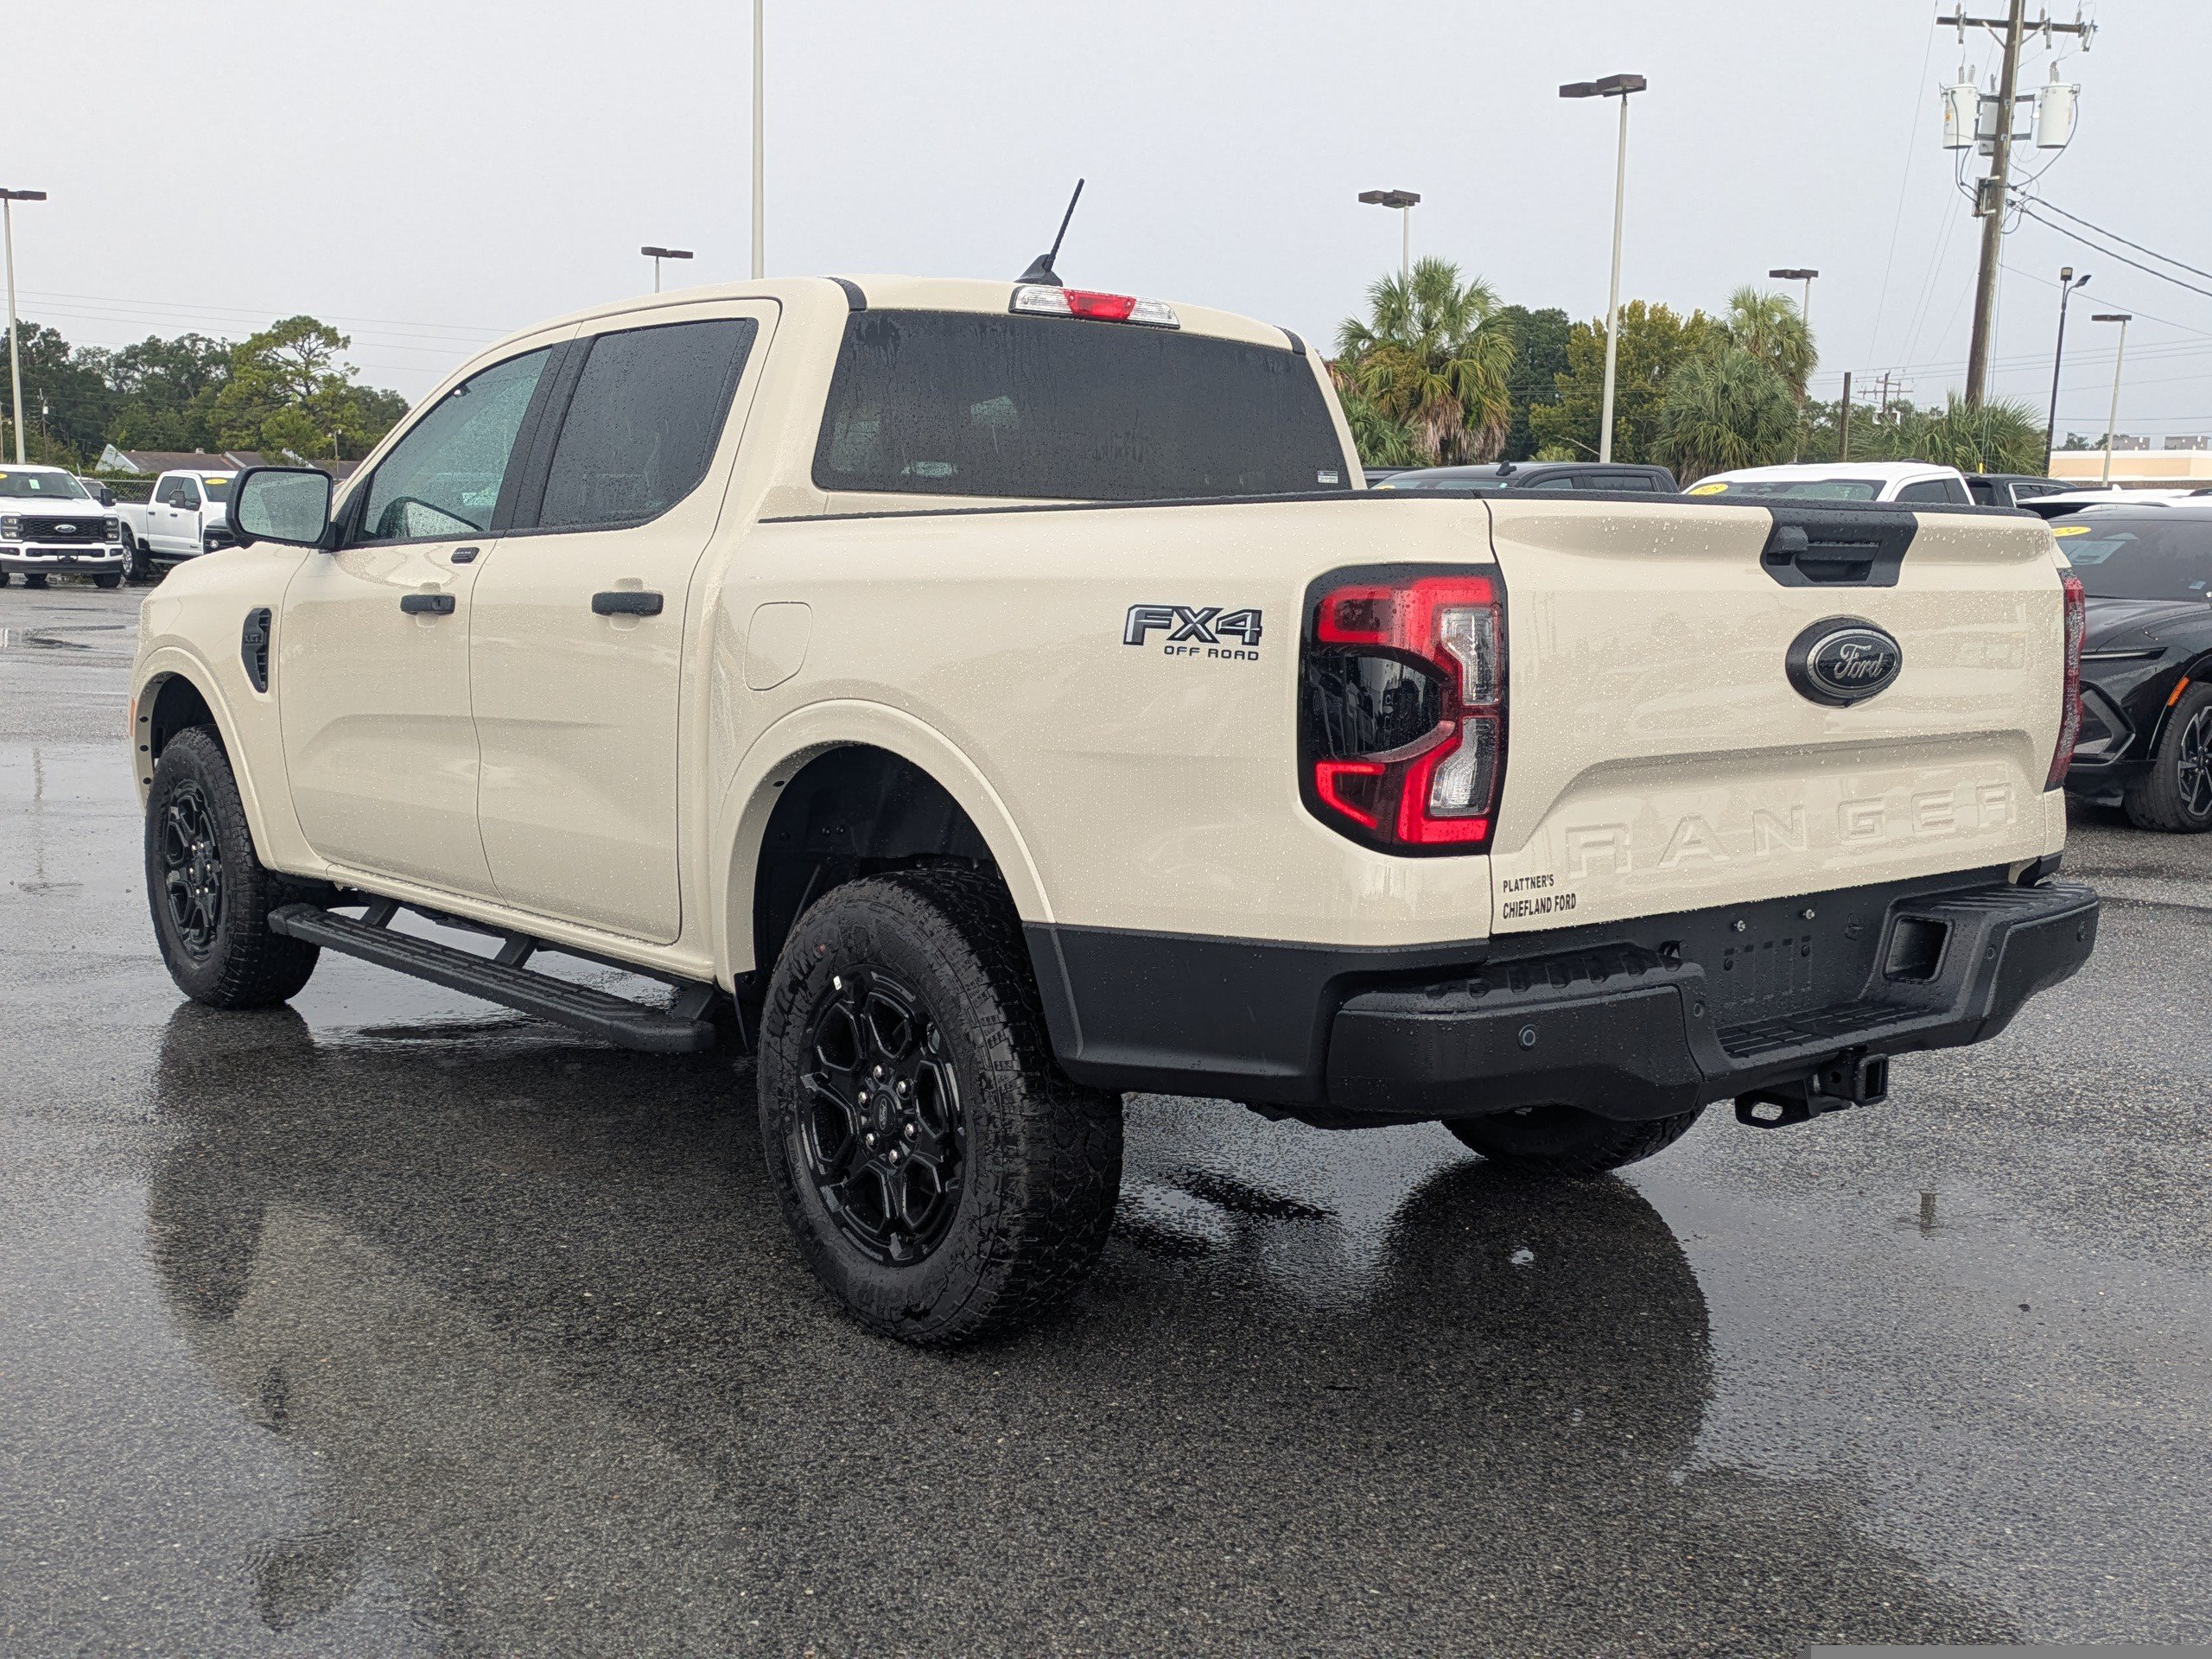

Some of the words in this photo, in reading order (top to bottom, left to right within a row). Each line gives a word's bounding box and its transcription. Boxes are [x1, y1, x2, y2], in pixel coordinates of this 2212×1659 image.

[1123, 604, 1262, 646] FX4
[1164, 645, 1200, 657] OFF
[1208, 648, 1259, 661] ROAD
[1834, 643, 1885, 680] Ford
[1565, 782, 2018, 879] RANGER
[1503, 874, 1554, 893] PLATTNER'S
[1503, 897, 1553, 919] CHIEFLAND
[1554, 893, 1577, 912] FORD
